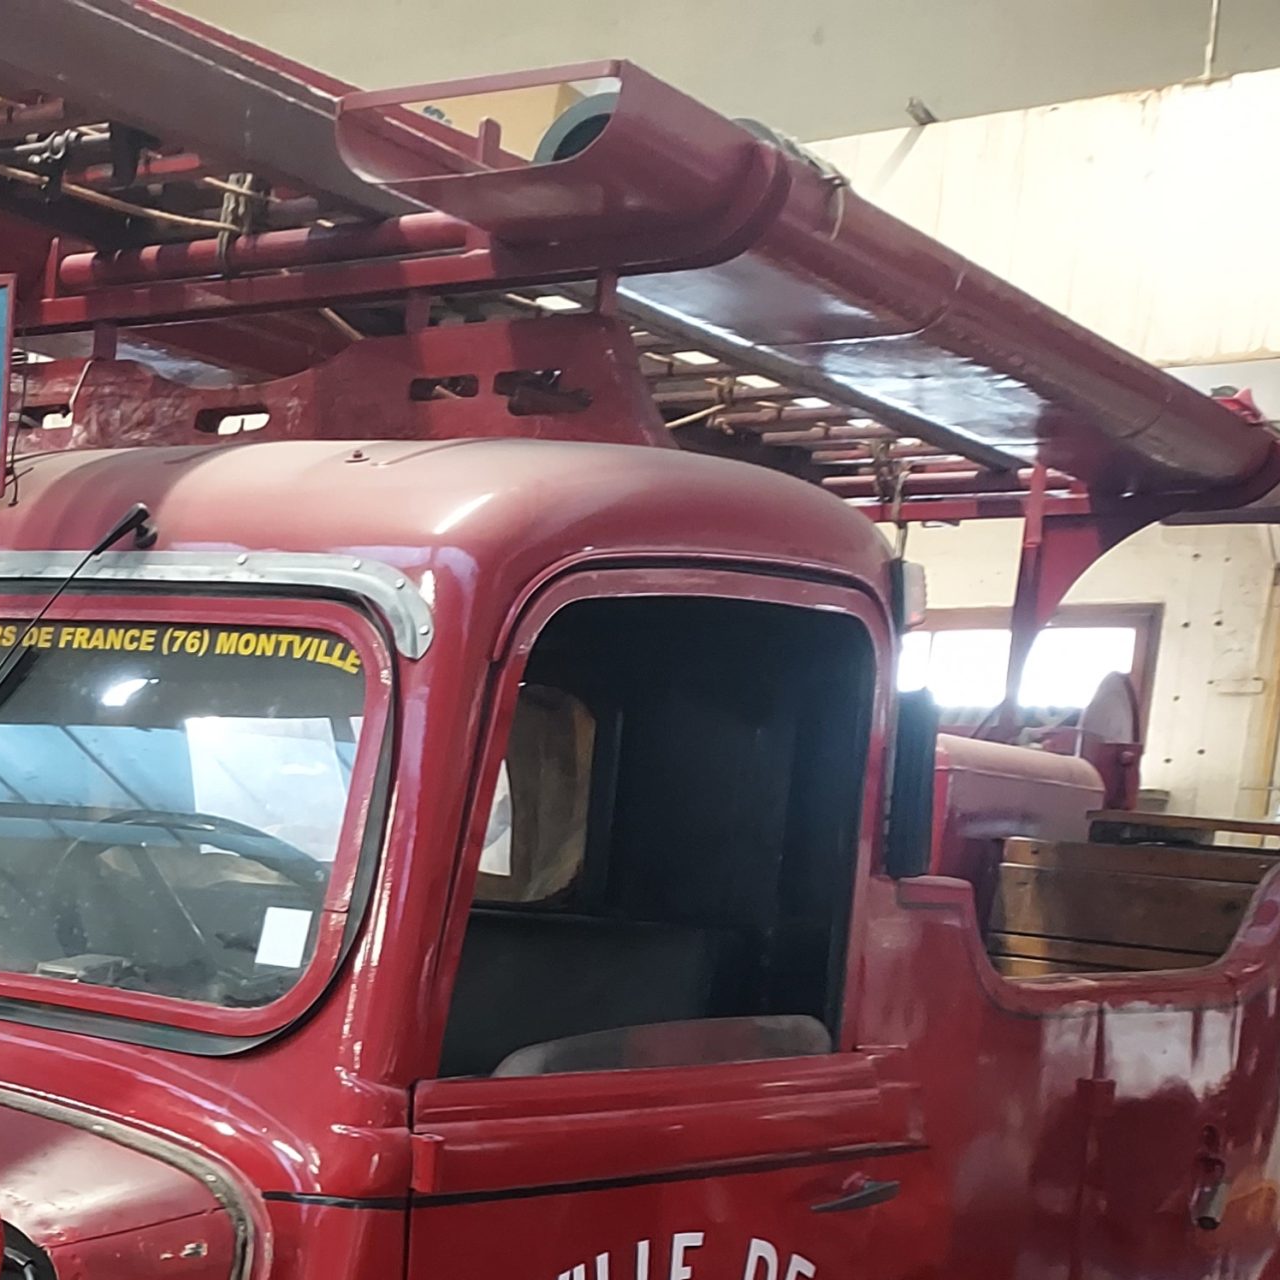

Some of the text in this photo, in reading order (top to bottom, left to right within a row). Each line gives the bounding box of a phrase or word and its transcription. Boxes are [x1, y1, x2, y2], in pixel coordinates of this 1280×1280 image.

[22, 627, 55, 648] DE
[58, 627, 158, 651] FRANCE
[162, 628, 211, 656] (76)
[214, 632, 362, 674] MONTVILLE
